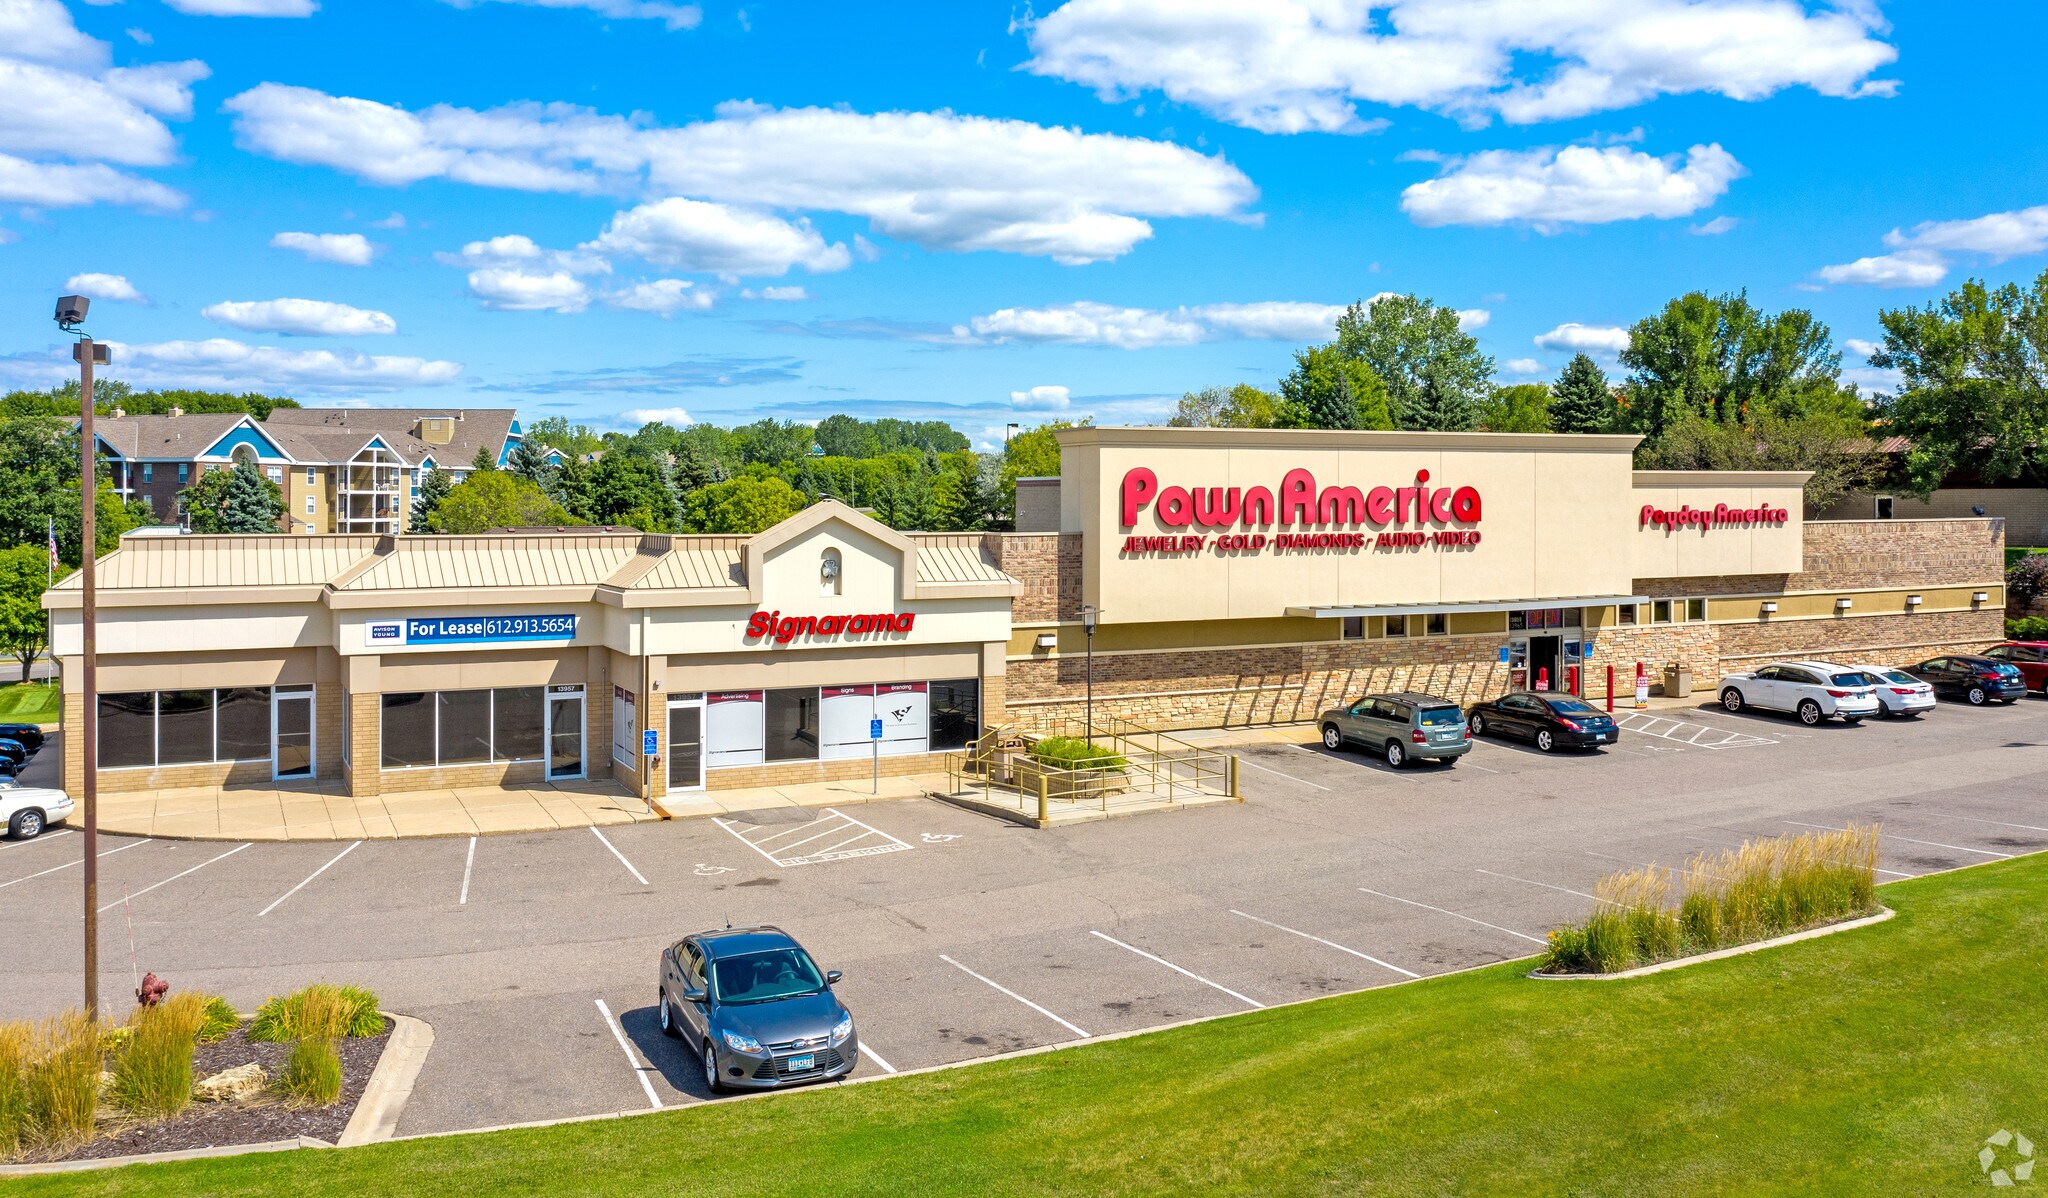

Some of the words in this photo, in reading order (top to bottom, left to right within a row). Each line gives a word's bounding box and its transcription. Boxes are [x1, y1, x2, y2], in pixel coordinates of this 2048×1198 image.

[1122, 535, 1208, 552] JEWELRY
[1217, 534, 1267, 550] GOLD
[1276, 533, 1365, 549] DIAMONDS
[1376, 532, 1426, 547] AUDIO
[1433, 530, 1482, 545] VIDEO
[409, 622, 436, 636] For
[440, 620, 483, 635] Lease
[487, 618, 573, 634] 612.913.5654
[747, 610, 915, 644] Signarama
[1529, 609, 1559, 625] OPEN
